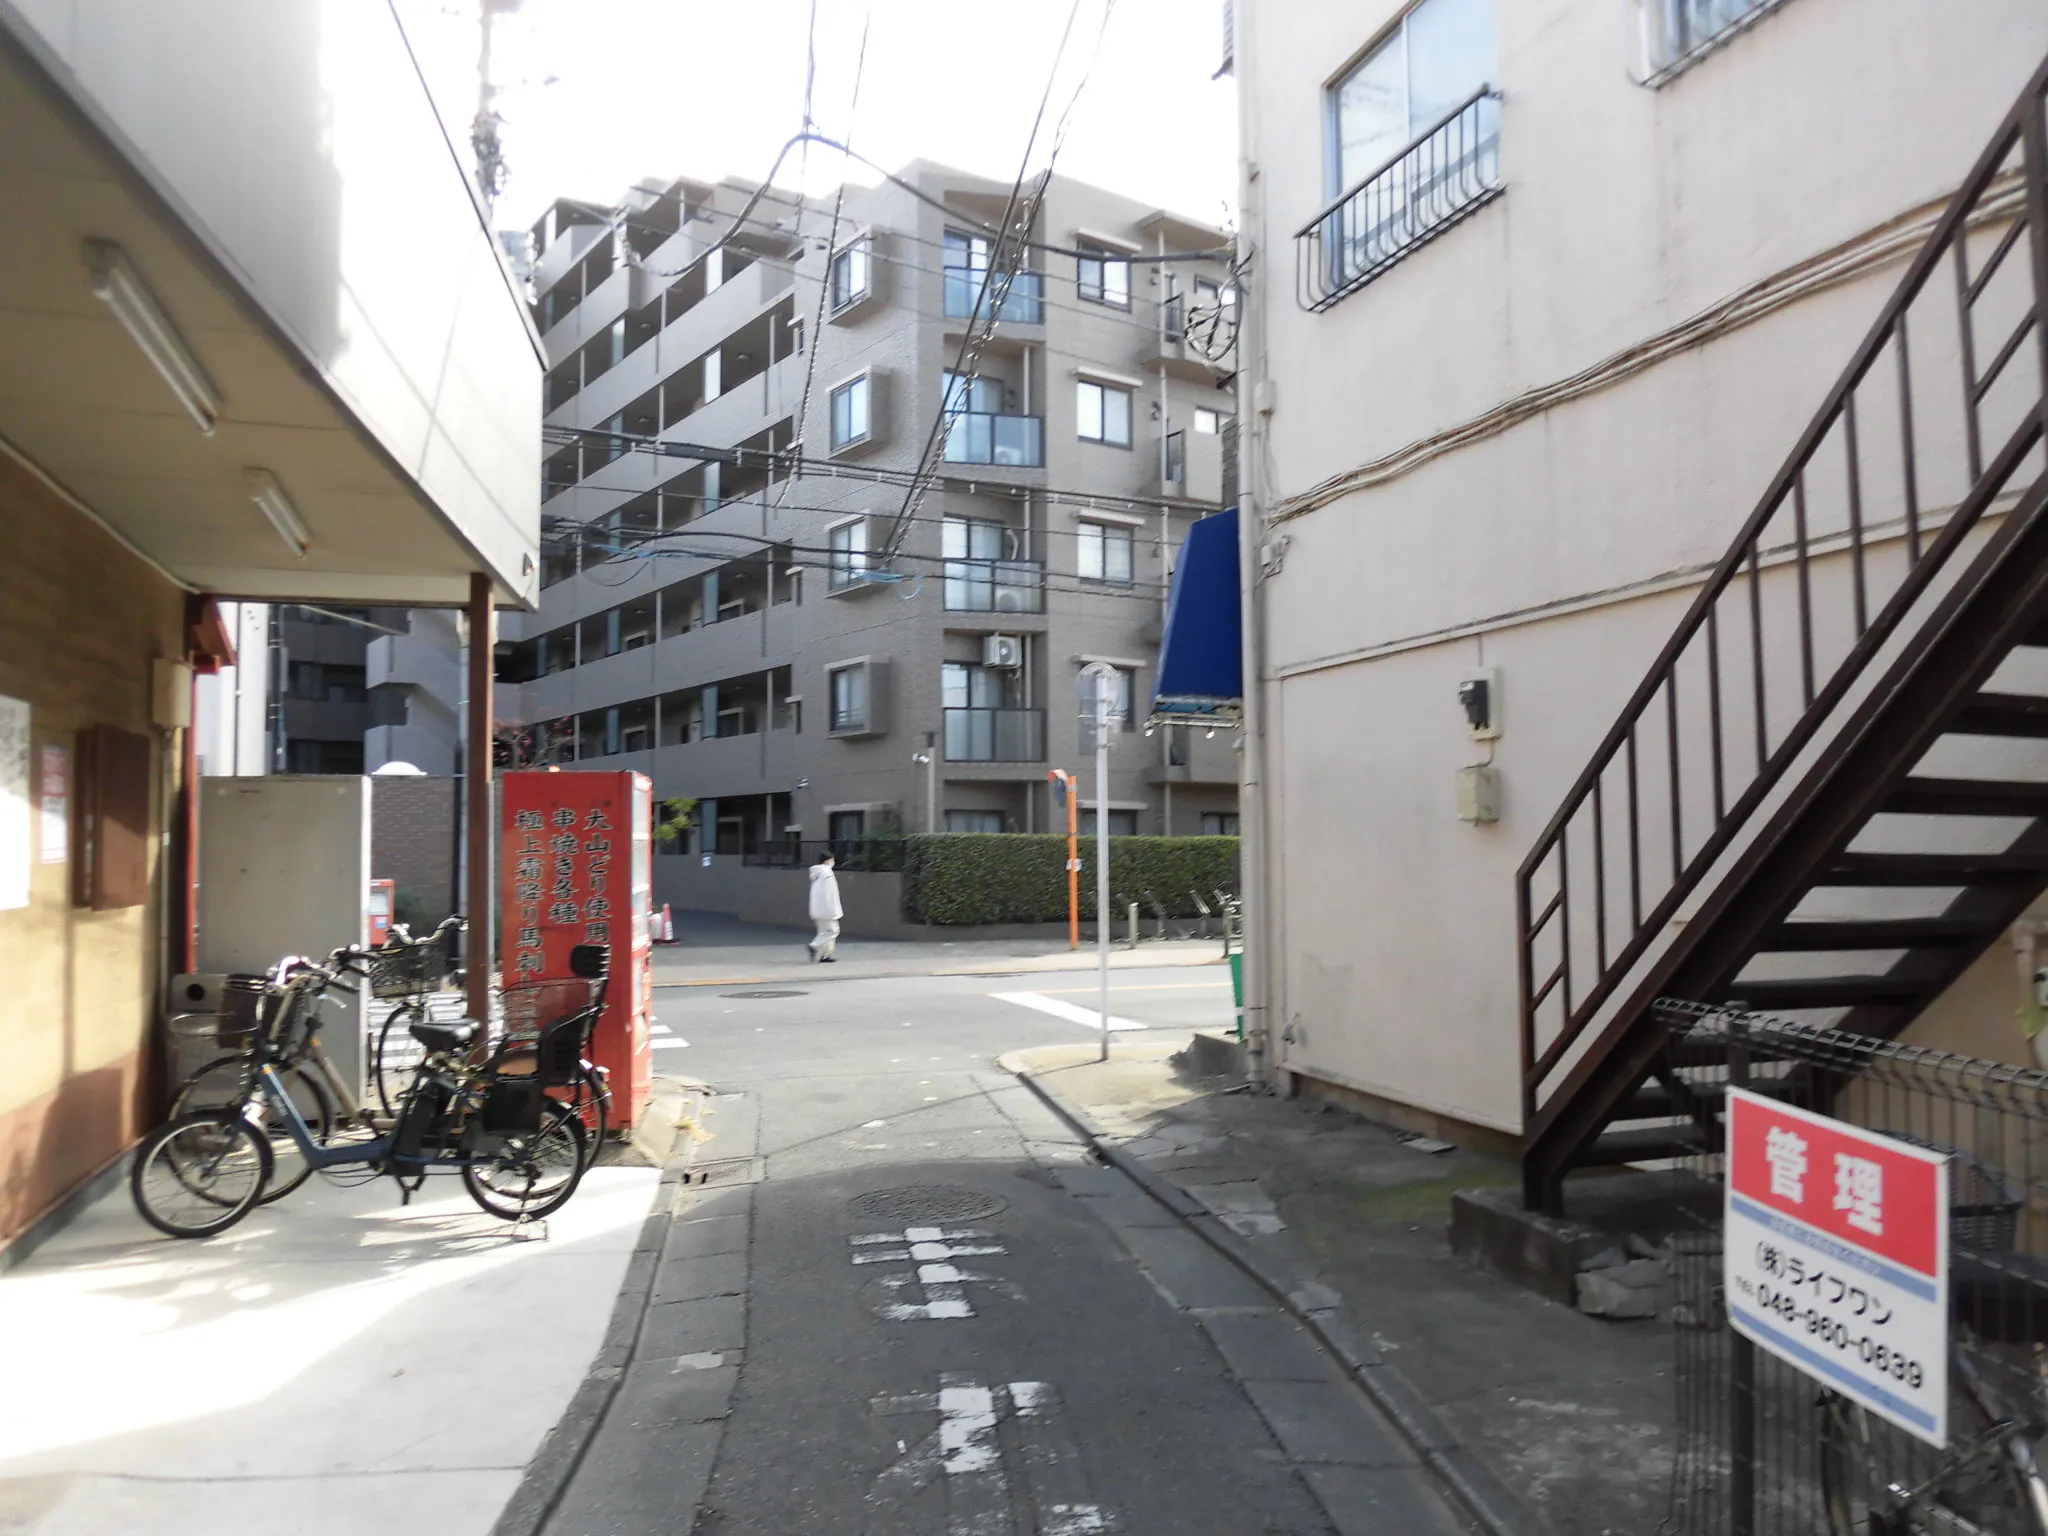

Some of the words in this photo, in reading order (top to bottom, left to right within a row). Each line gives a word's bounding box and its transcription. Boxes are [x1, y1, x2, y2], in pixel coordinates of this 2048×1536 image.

[548, 807, 581, 925] 串焼き各種
[582, 808, 614, 943] 大山どり使用
[1765, 1126, 1884, 1236] 管理
